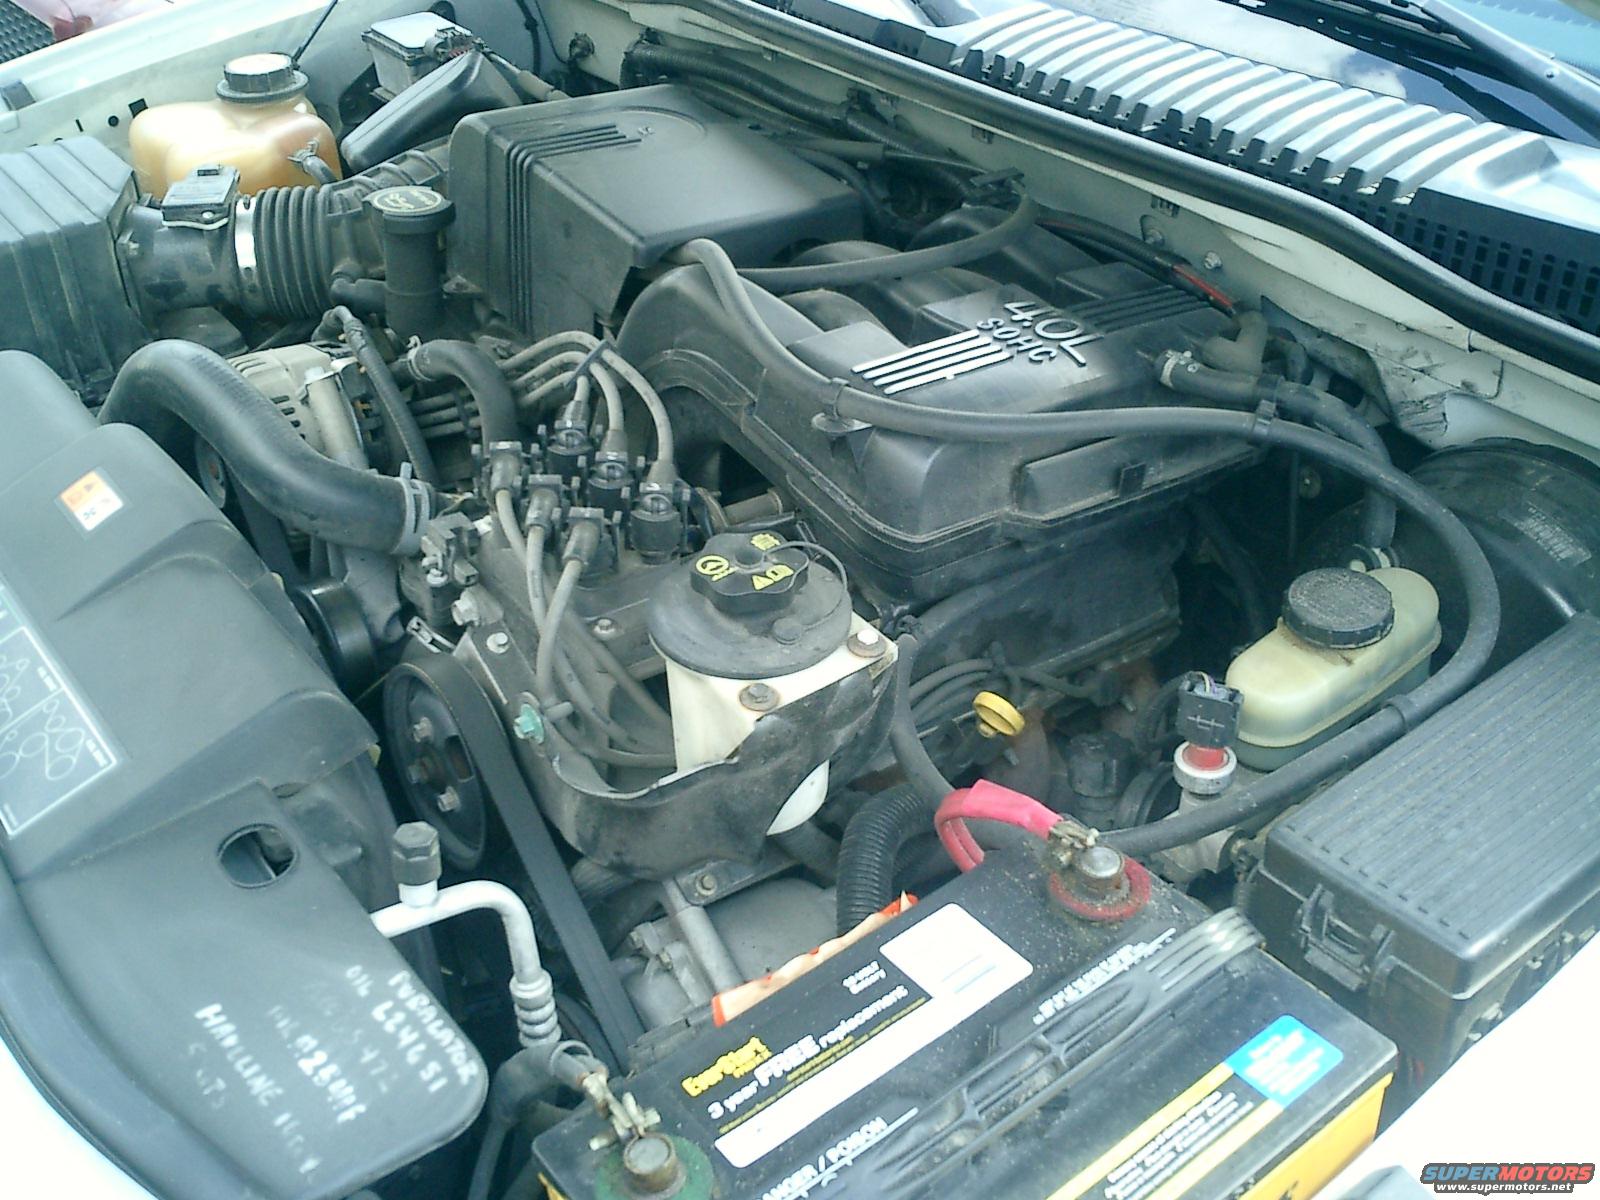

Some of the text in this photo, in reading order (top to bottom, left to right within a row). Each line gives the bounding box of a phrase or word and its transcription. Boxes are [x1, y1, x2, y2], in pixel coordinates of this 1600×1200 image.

[976, 317, 1058, 362] SOHC
[1003, 301, 1104, 366] 4.0L
[707, 1101, 725, 1120] 3
[723, 1080, 759, 1113] year
[753, 1034, 821, 1087] FREE
[818, 984, 909, 1049] replacement
